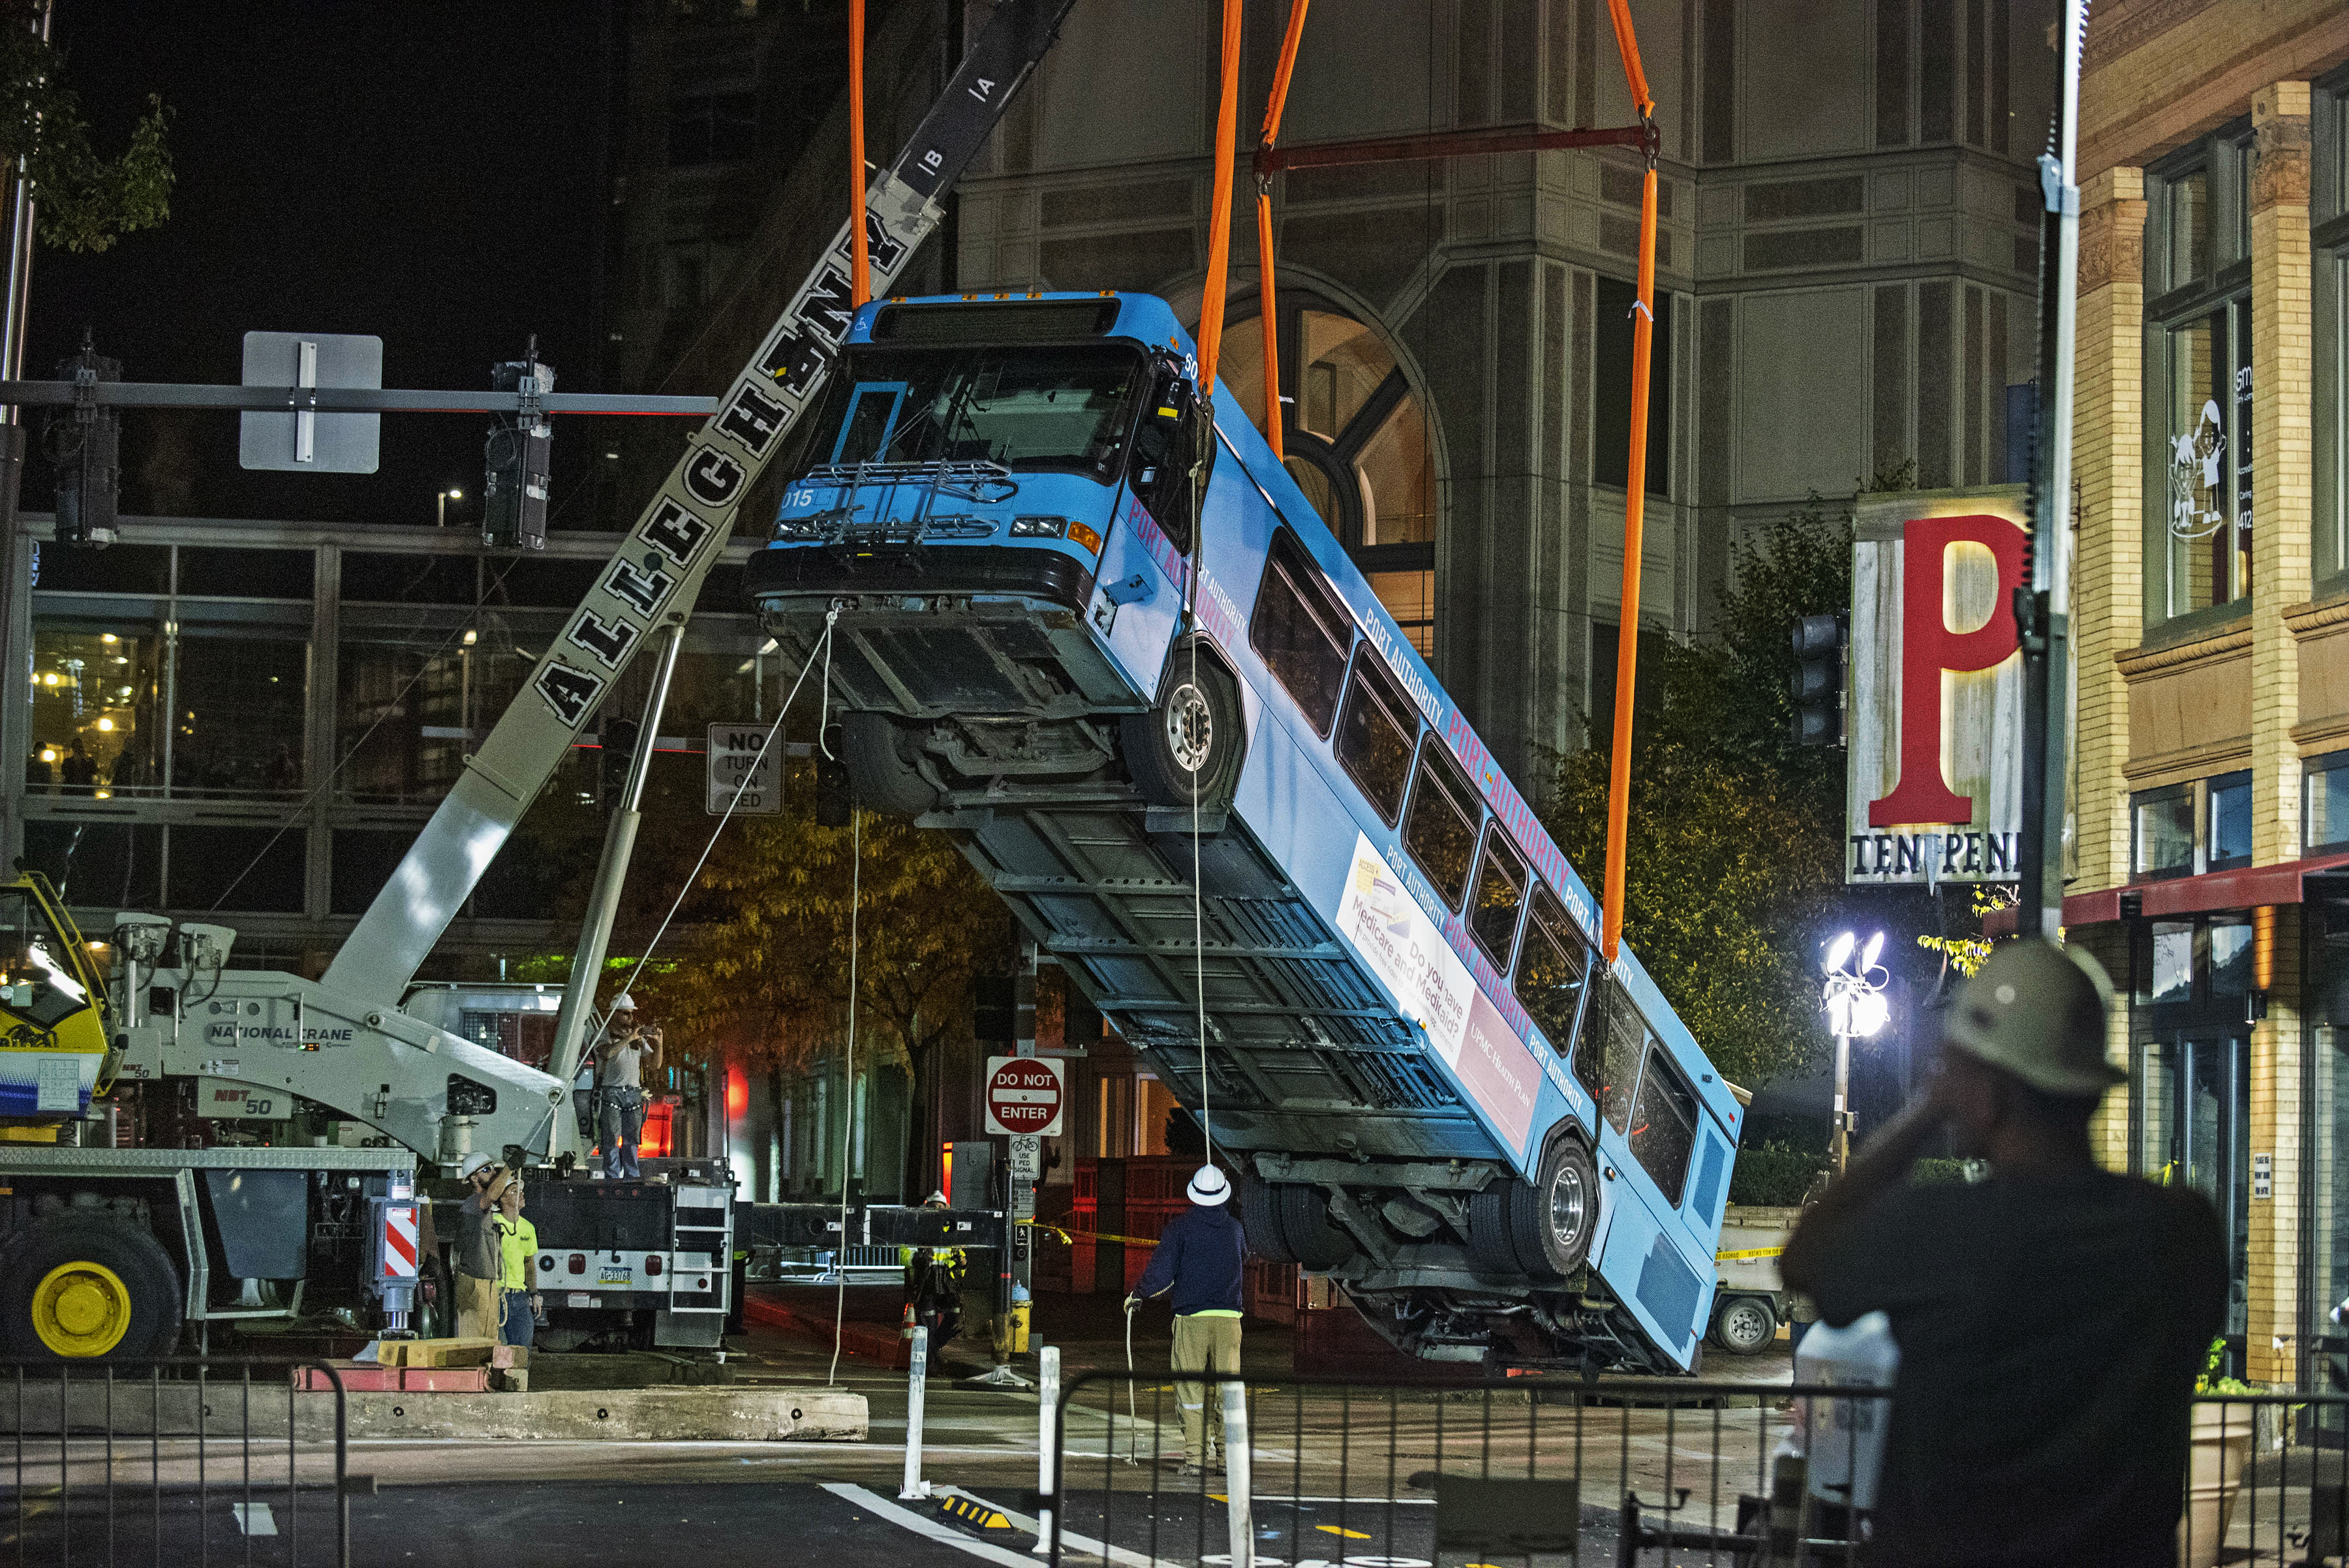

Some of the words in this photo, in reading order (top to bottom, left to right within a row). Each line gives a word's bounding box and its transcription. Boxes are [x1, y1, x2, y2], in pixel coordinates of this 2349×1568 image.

[533, 206, 908, 730] ALLEGHENY
[2239, 510, 2252, 530] 412
[1129, 497, 1167, 559] PORT
[1163, 545, 1237, 649] AUTORITY
[1208, 574, 1248, 636] AUTHORITY
[1364, 607, 1392, 662] PORT
[1390, 644, 1444, 727] AUTHORITY
[1869, 514, 2031, 829] P
[727, 756, 768, 769] TURN
[729, 733, 764, 750] NO
[1447, 709, 1490, 783] PORT
[1487, 770, 1570, 897] AUTHORITY
[1850, 834, 1920, 874] TEN
[1942, 832, 2021, 874] PEN
[1386, 844, 1407, 880] PORT
[1405, 870, 1445, 931] AUTHORITY
[1564, 884, 1589, 929] PORT
[1353, 894, 1394, 957] Medicare
[1394, 953, 1415, 980] and
[1410, 942, 1425, 967] Do
[1426, 962, 1444, 992] you
[1443, 986, 1462, 1019] have
[1444, 912, 1476, 964] PORT
[1473, 953, 1532, 1043] AUTHORITY
[1471, 1022, 1495, 1058] UPMC
[214, 1090, 251, 1101] NBT
[997, 1073, 1018, 1086] DO
[1024, 1074, 1052, 1086] NOT
[1529, 1034, 1548, 1068] PORT
[1546, 1057, 1584, 1115] AUTHORITY
[245, 1099, 272, 1115] 50
[1002, 1107, 1047, 1119] ENTER
